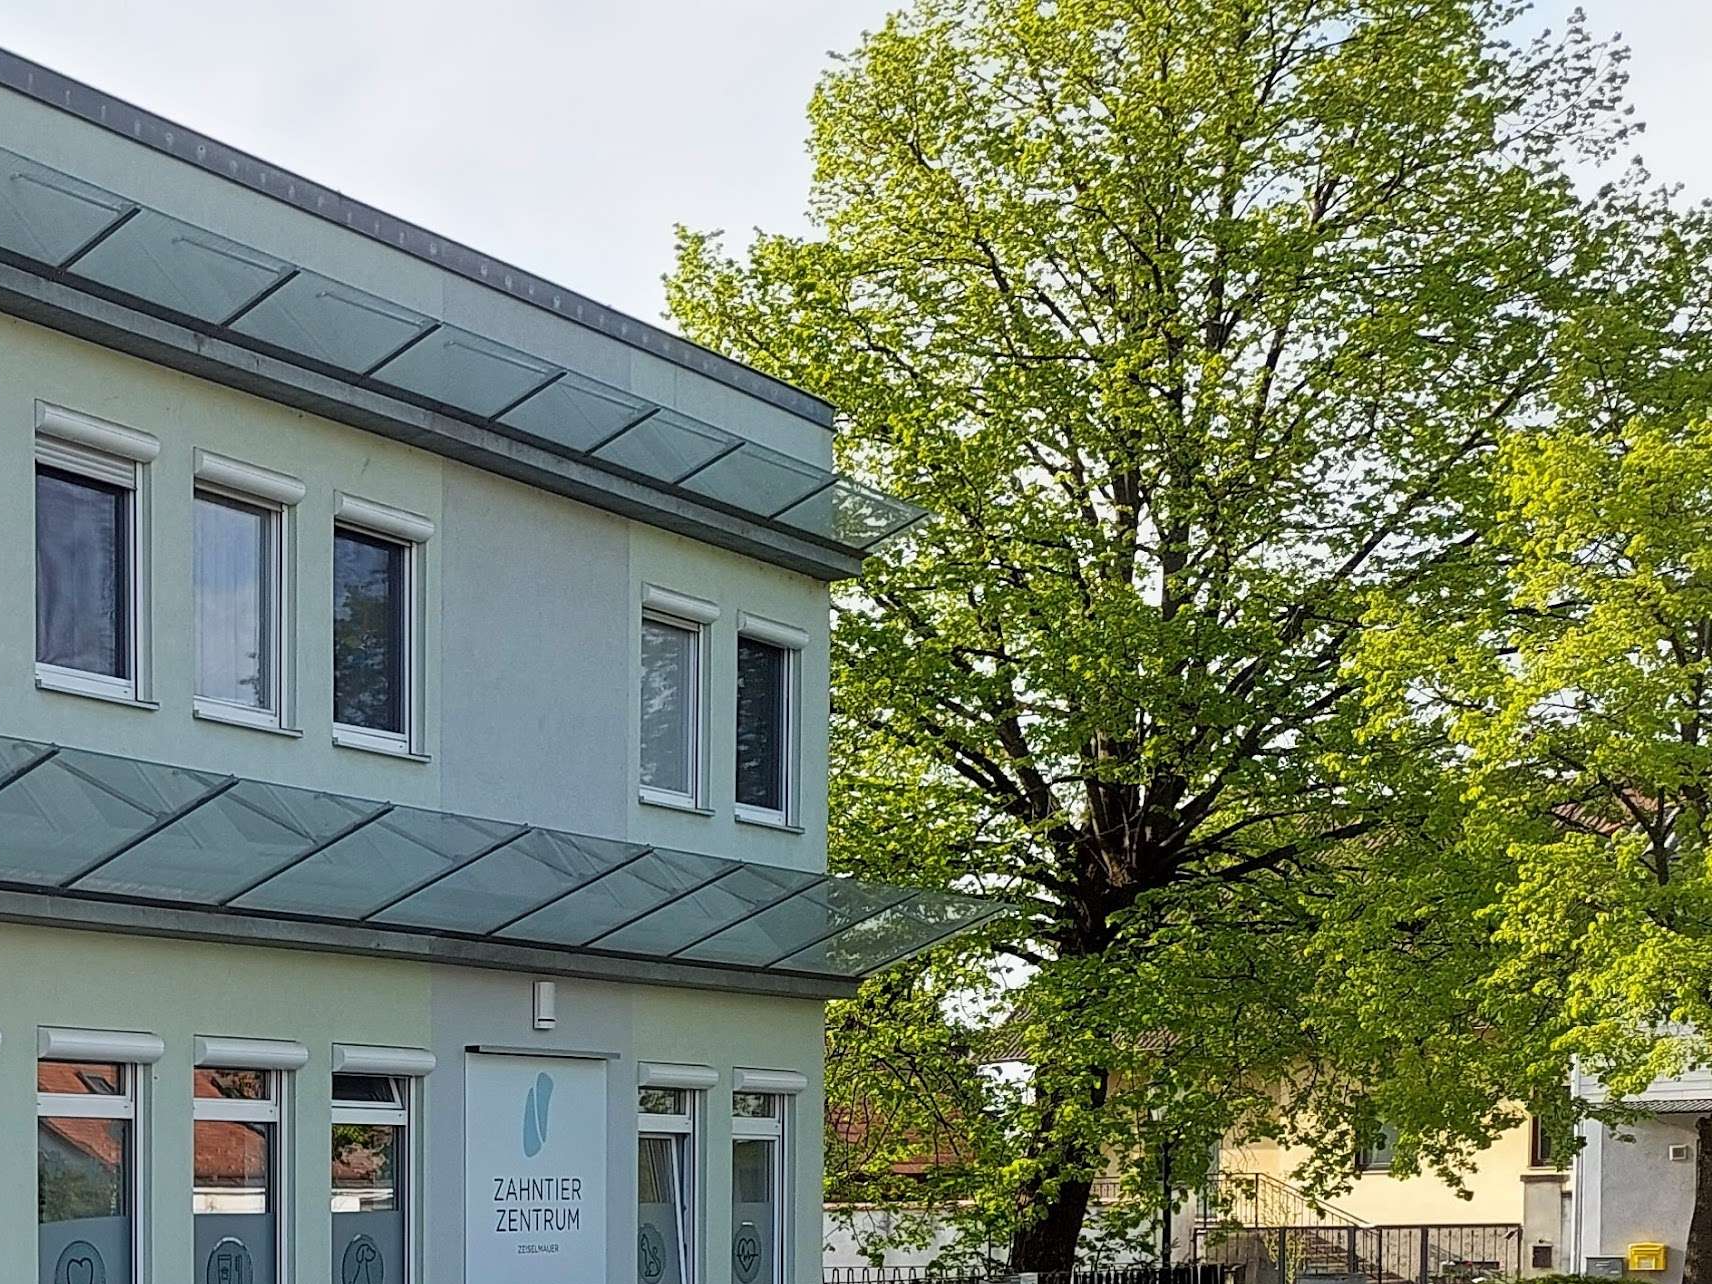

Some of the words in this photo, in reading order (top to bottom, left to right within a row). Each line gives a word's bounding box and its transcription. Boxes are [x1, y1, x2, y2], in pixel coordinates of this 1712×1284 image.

[493, 1178, 582, 1201] ZAHNTIER
[495, 1208, 580, 1232] ZENTRUM
[517, 1244, 559, 1254] ZEISELMAUER
